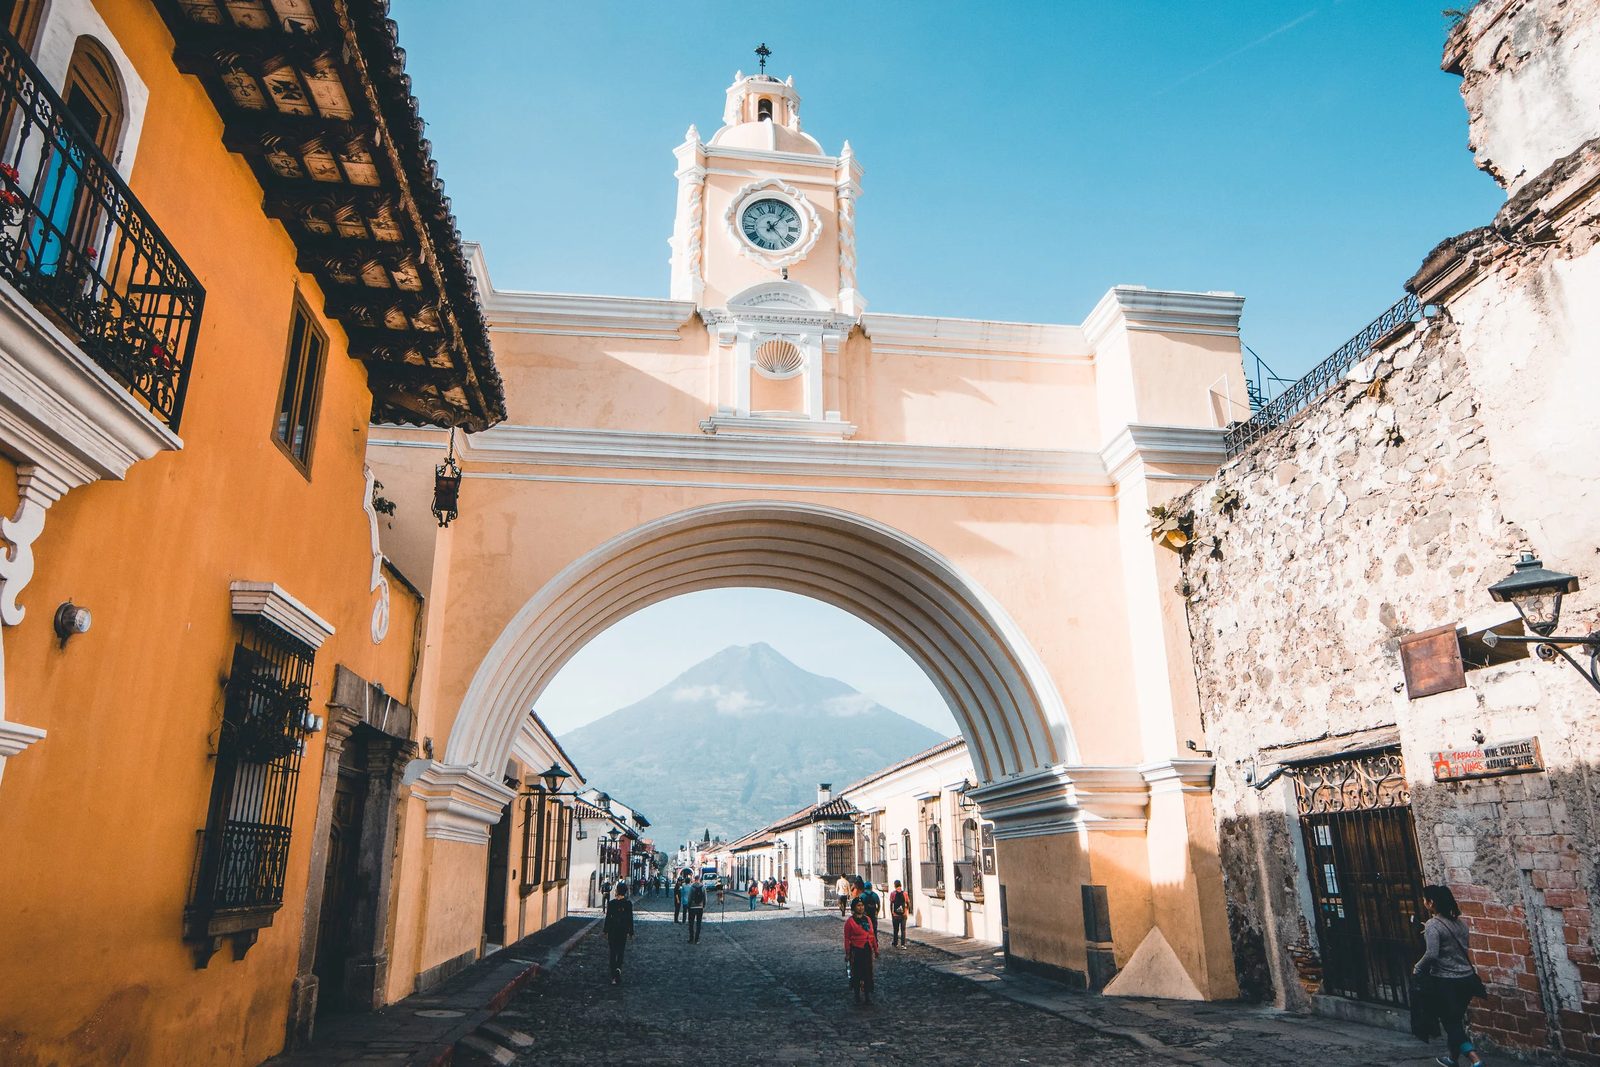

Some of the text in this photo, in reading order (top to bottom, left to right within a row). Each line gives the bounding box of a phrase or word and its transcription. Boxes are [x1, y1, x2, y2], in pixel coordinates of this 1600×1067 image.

[1452, 749, 1482, 761] TABACOS
[1484, 743, 1531, 758] WINE CHOCOLATE
[1513, 755, 1534, 766] COFFEE
